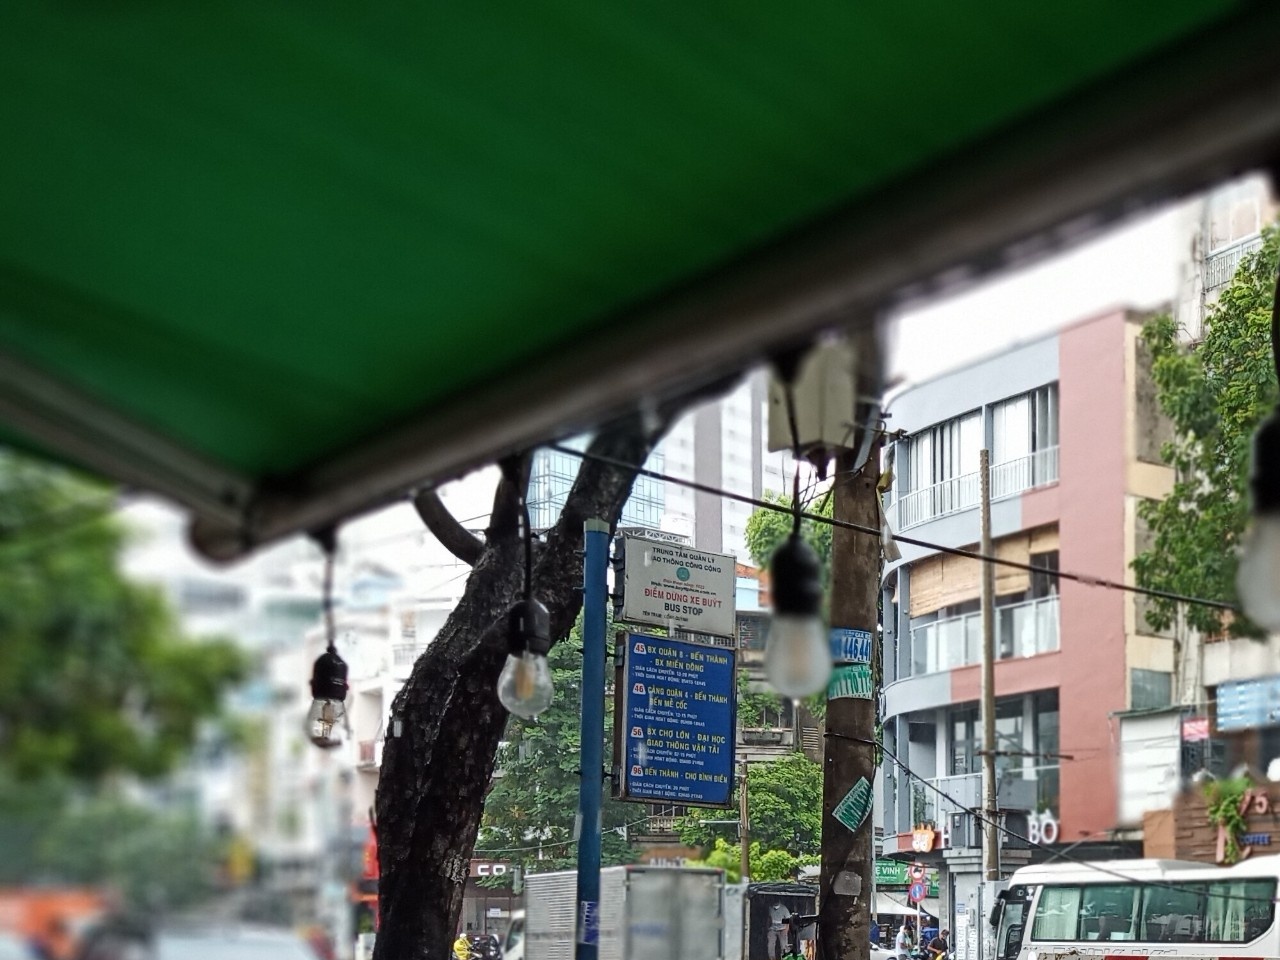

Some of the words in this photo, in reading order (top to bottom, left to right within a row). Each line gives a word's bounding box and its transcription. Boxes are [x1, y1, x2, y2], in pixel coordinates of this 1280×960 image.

[652, 547, 674, 556] TRUNG
[675, 550, 688, 559] TÂM
[663, 557, 684, 566] THÔNG
[685, 561, 703, 570] CÔNG
[704, 564, 722, 573] CỘNG
[644, 586, 664, 599] ĐIỂM
[690, 596, 700, 605] XE
[664, 602, 680, 613] BUS
[682, 605, 703, 616] STOP
[647, 646, 656, 654] BX
[646, 738, 663, 748] GIAO
[666, 740, 690, 750] THÔNG
